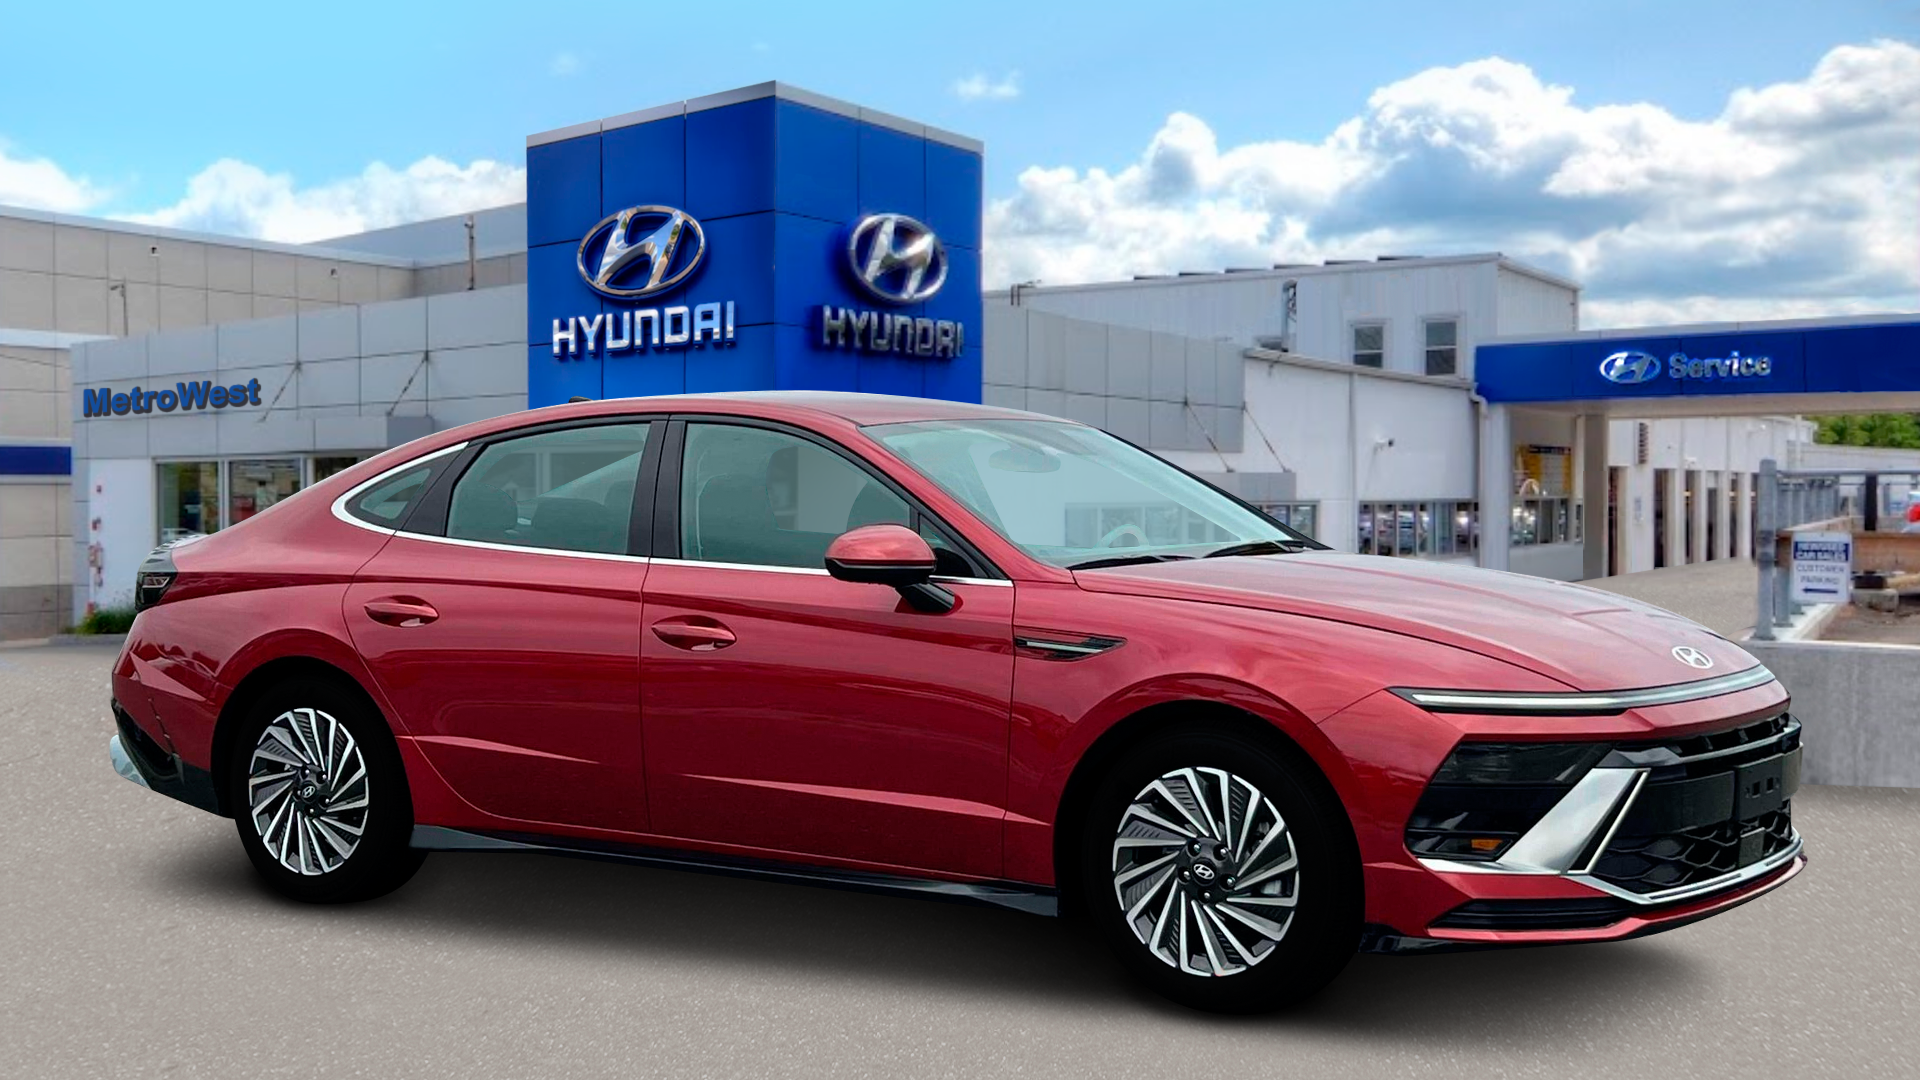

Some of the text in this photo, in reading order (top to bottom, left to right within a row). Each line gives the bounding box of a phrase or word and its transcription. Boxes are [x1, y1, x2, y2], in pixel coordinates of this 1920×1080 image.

[552, 300, 735, 357] HYUNDAI
[821, 304, 965, 360] HYUNDAI
[1668, 351, 1772, 379] Service
[82, 377, 262, 418] MetroWest
